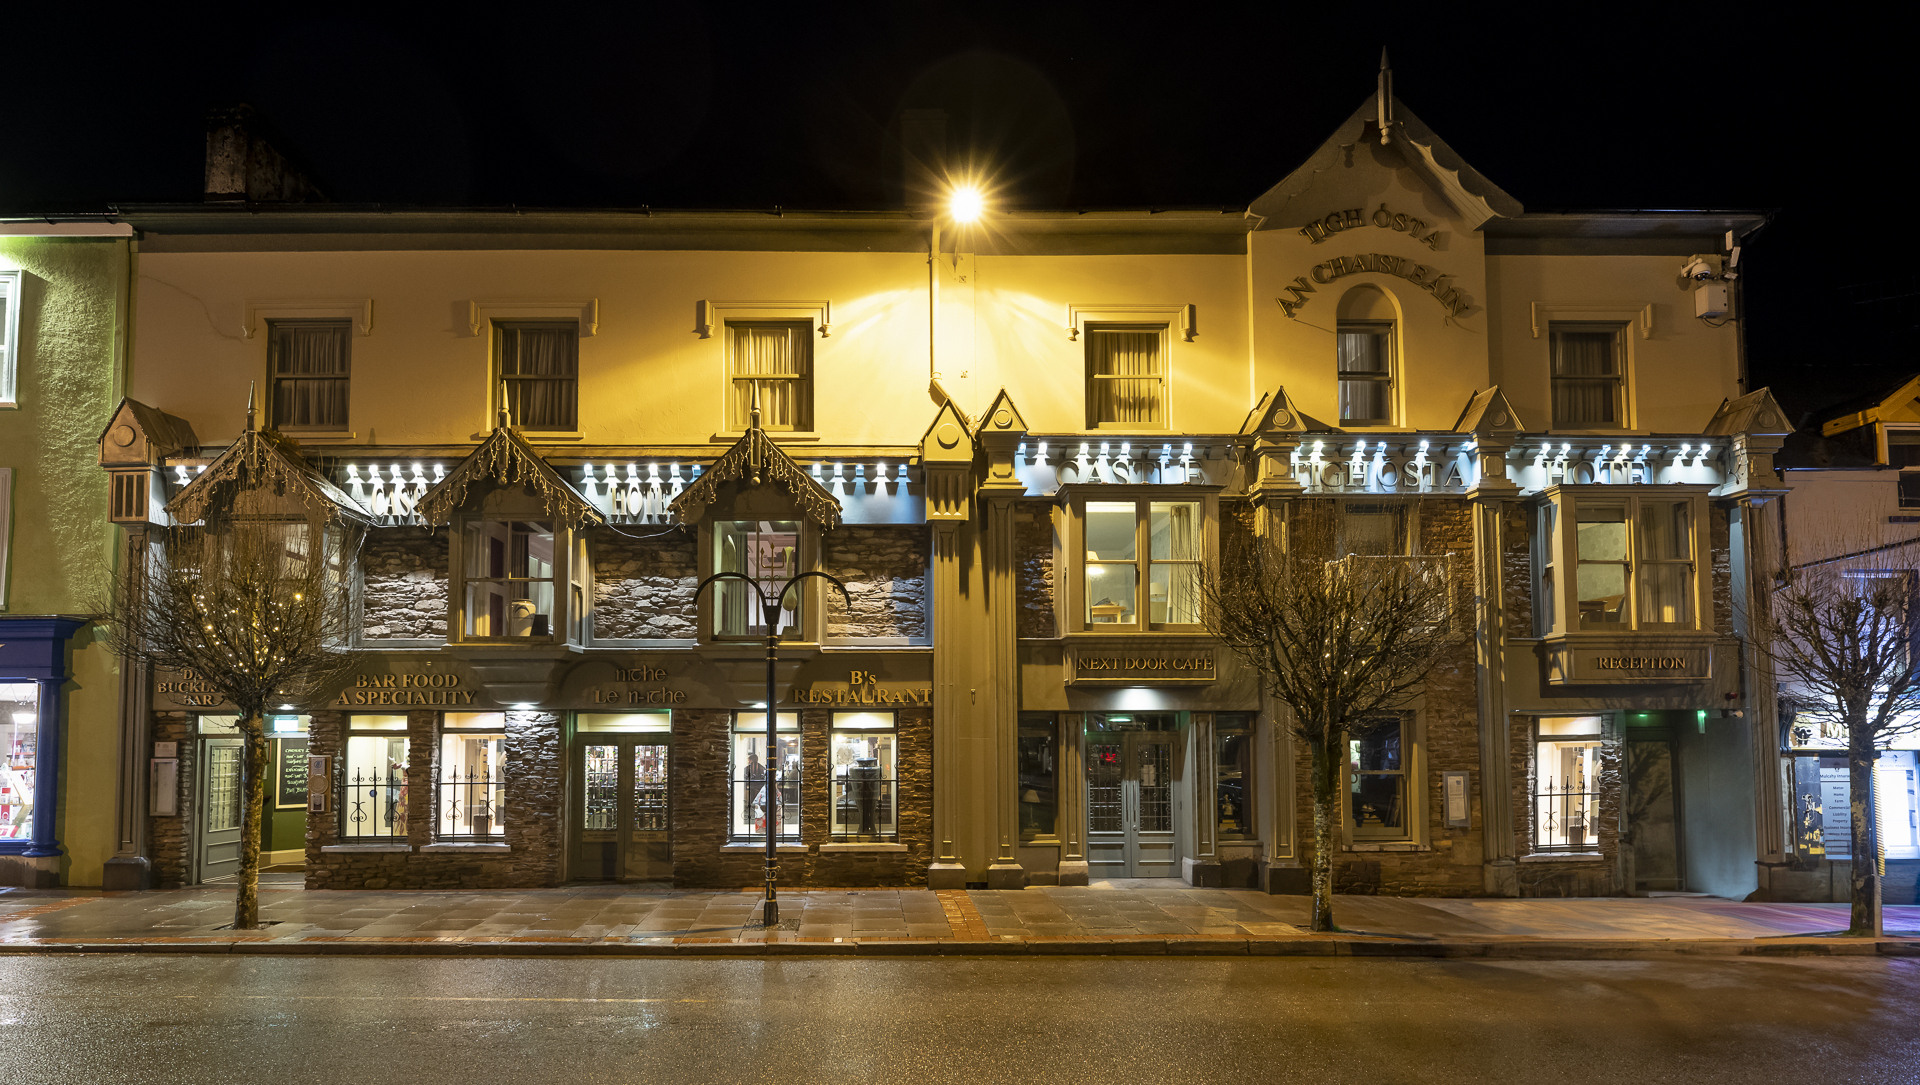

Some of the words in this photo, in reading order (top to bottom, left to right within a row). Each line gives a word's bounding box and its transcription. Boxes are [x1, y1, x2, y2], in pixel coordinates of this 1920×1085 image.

[1298, 208, 1366, 244] TIGH
[1373, 203, 1438, 251] ÓSTA
[1276, 276, 1315, 317] AN
[1078, 658, 1120, 670] NEXT
[1124, 658, 1168, 670] DOOR
[1597, 657, 1686, 669] RECEPTION
[355, 674, 396, 688] BAR
[402, 674, 459, 688] FOOD
[850, 671, 877, 685] B's
[336, 691, 350, 705] A
[355, 691, 476, 705] SPECIALITY
[794, 689, 932, 703] RESTAURANT
